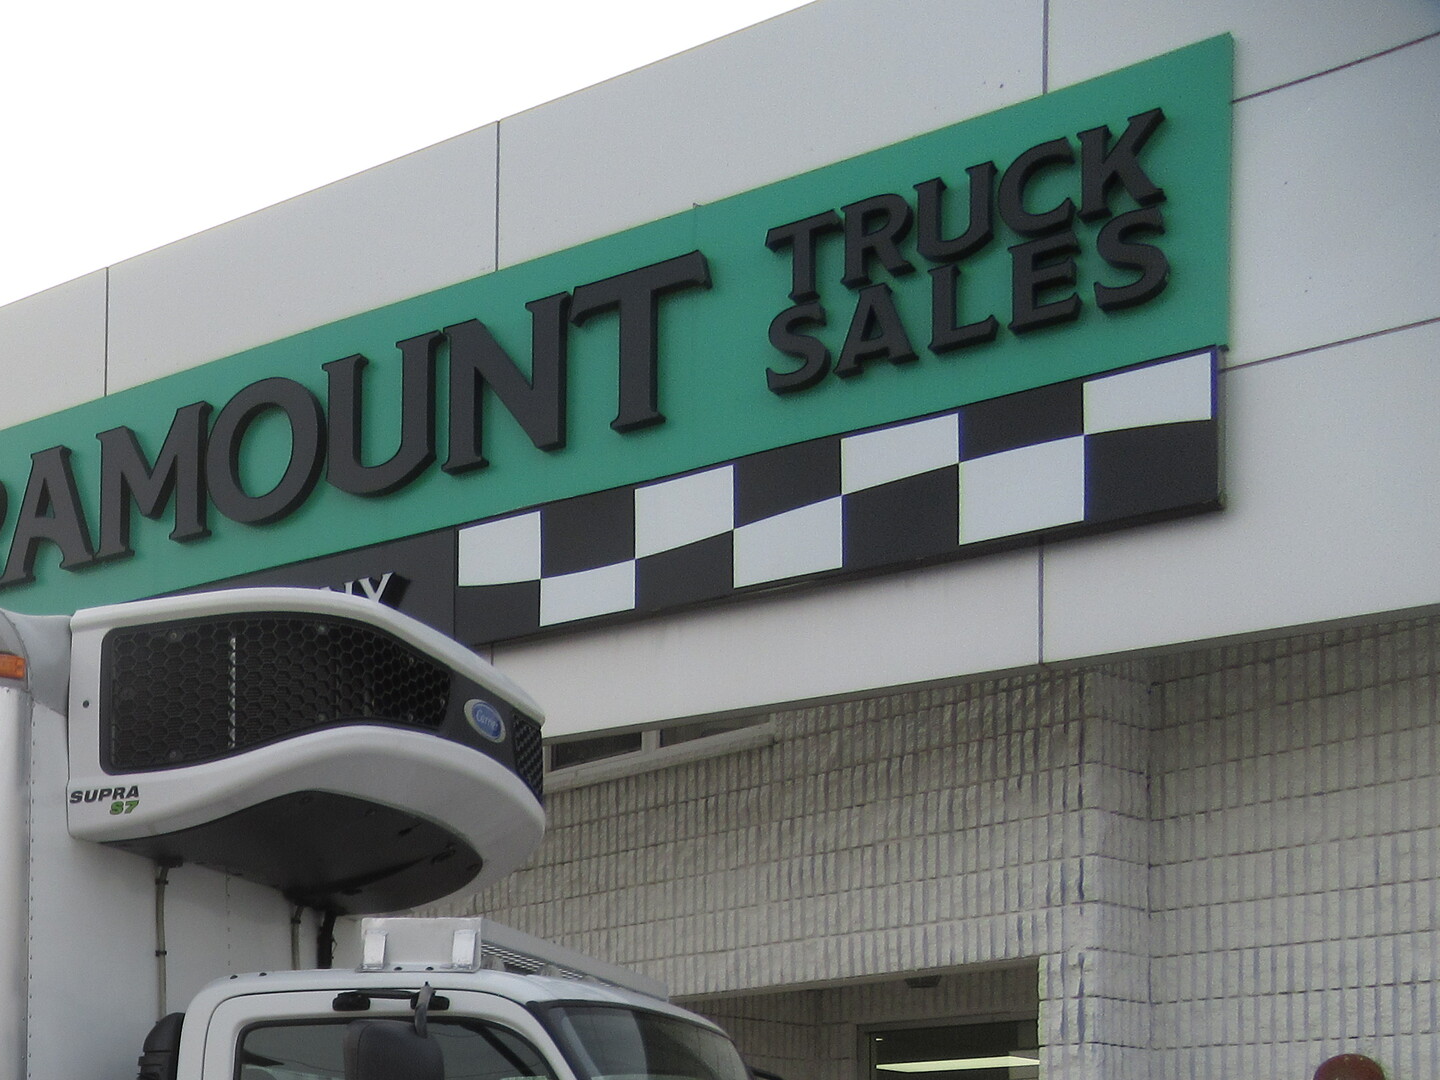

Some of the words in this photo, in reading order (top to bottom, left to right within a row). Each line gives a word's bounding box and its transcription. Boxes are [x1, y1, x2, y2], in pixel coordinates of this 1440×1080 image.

[765, 107, 1167, 305] TRUCK
[766, 206, 1170, 395] SALES
[70, 785, 139, 804] SUPRA
[109, 799, 140, 815] S7
